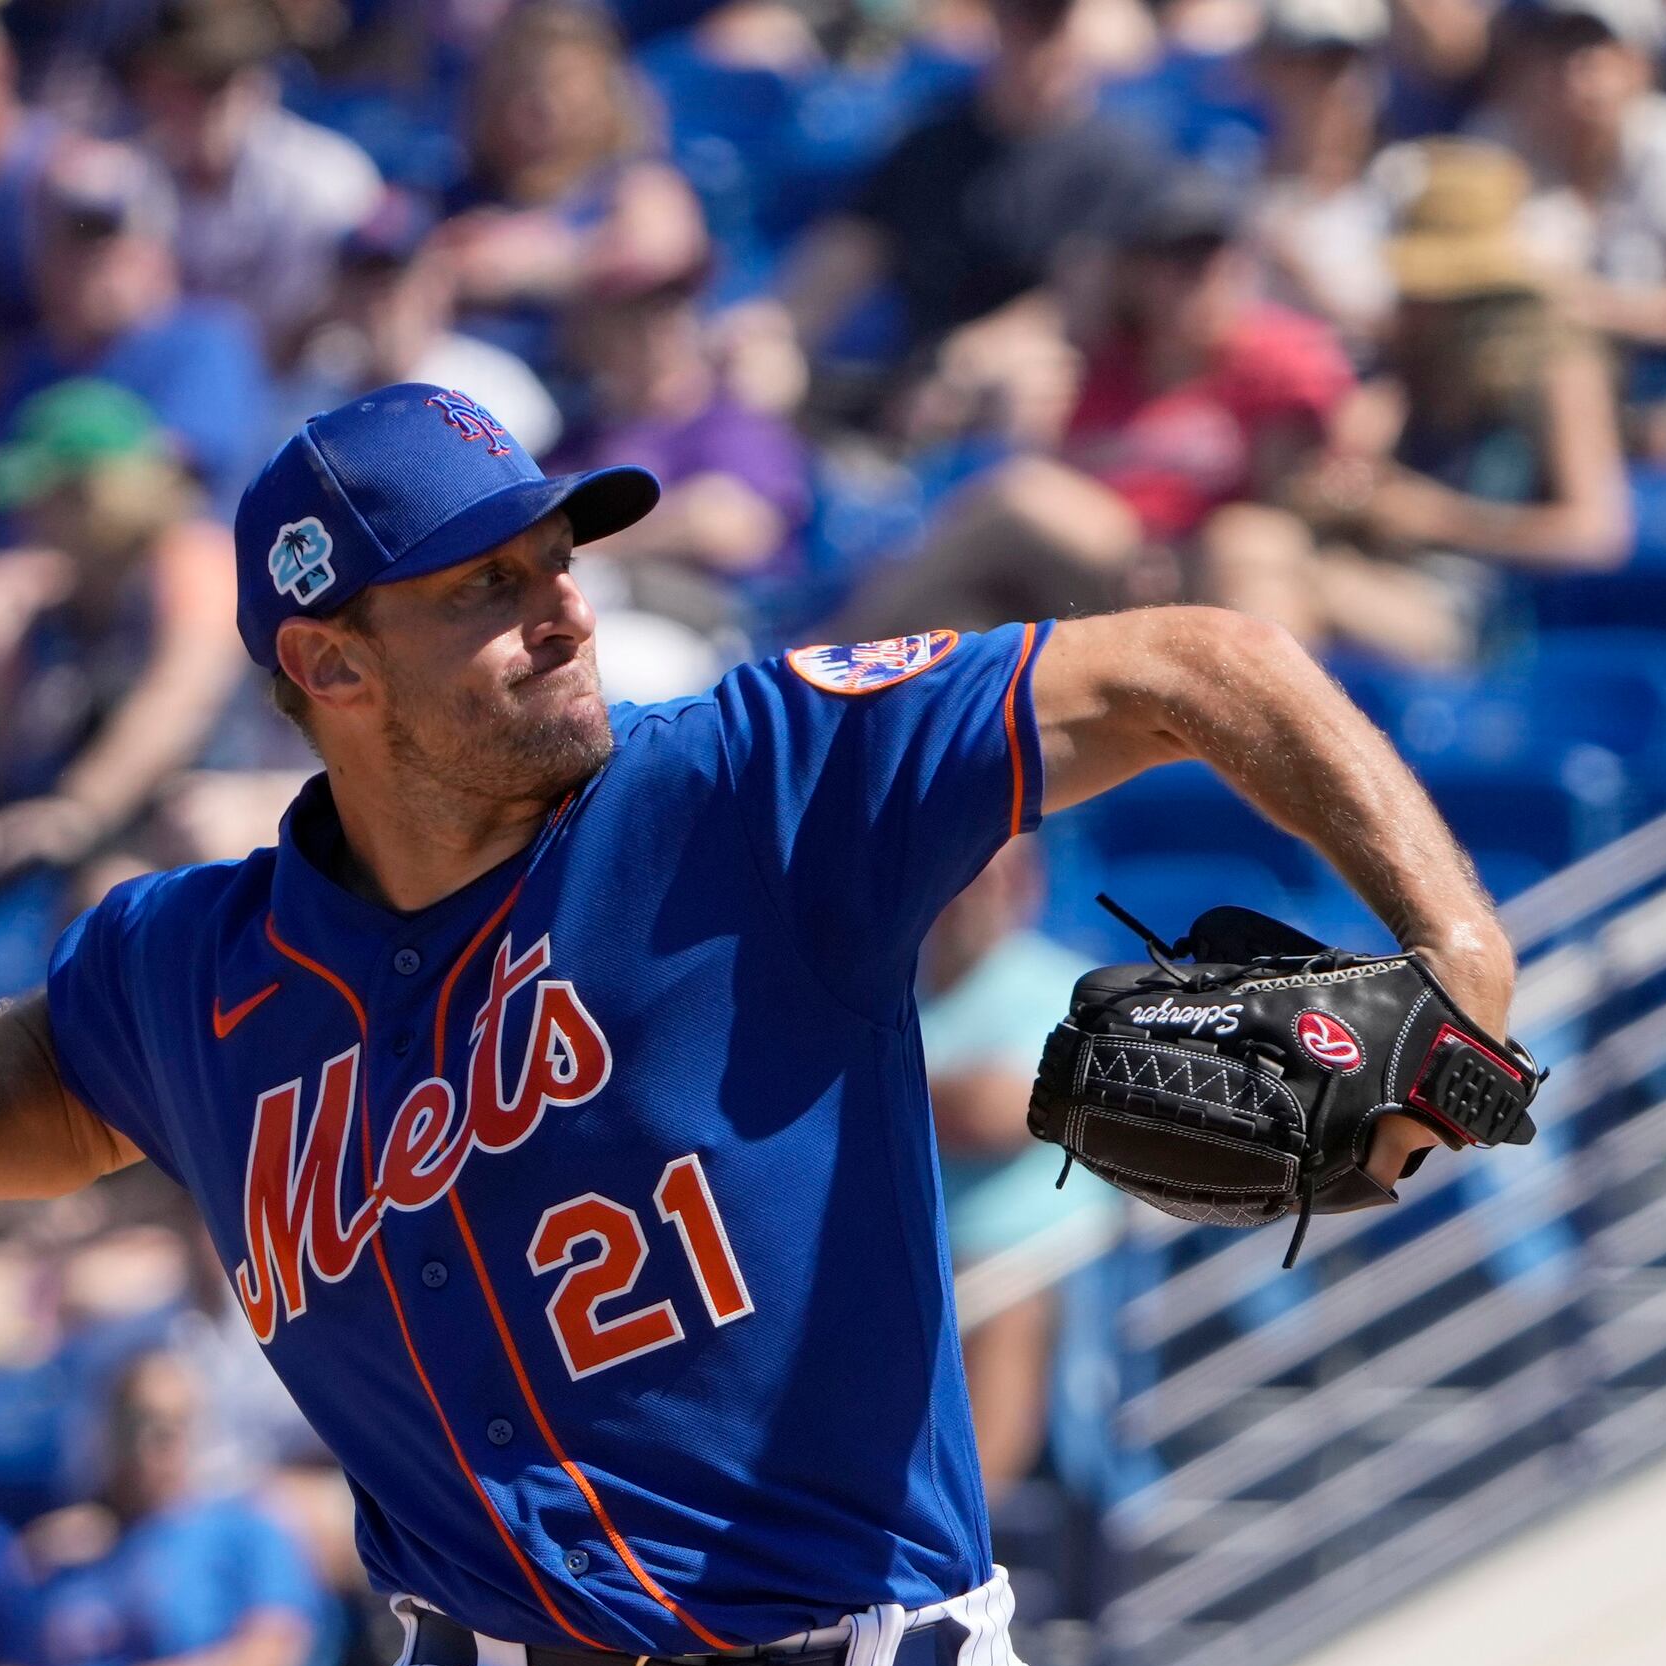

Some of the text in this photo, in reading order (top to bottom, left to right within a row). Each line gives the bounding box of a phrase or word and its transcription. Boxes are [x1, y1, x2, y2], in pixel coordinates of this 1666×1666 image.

[271, 523, 327, 587] 23
[1130, 997, 1244, 1035] Scherzer
[236, 931, 613, 1346] Mets
[526, 1152, 755, 1382] 21
